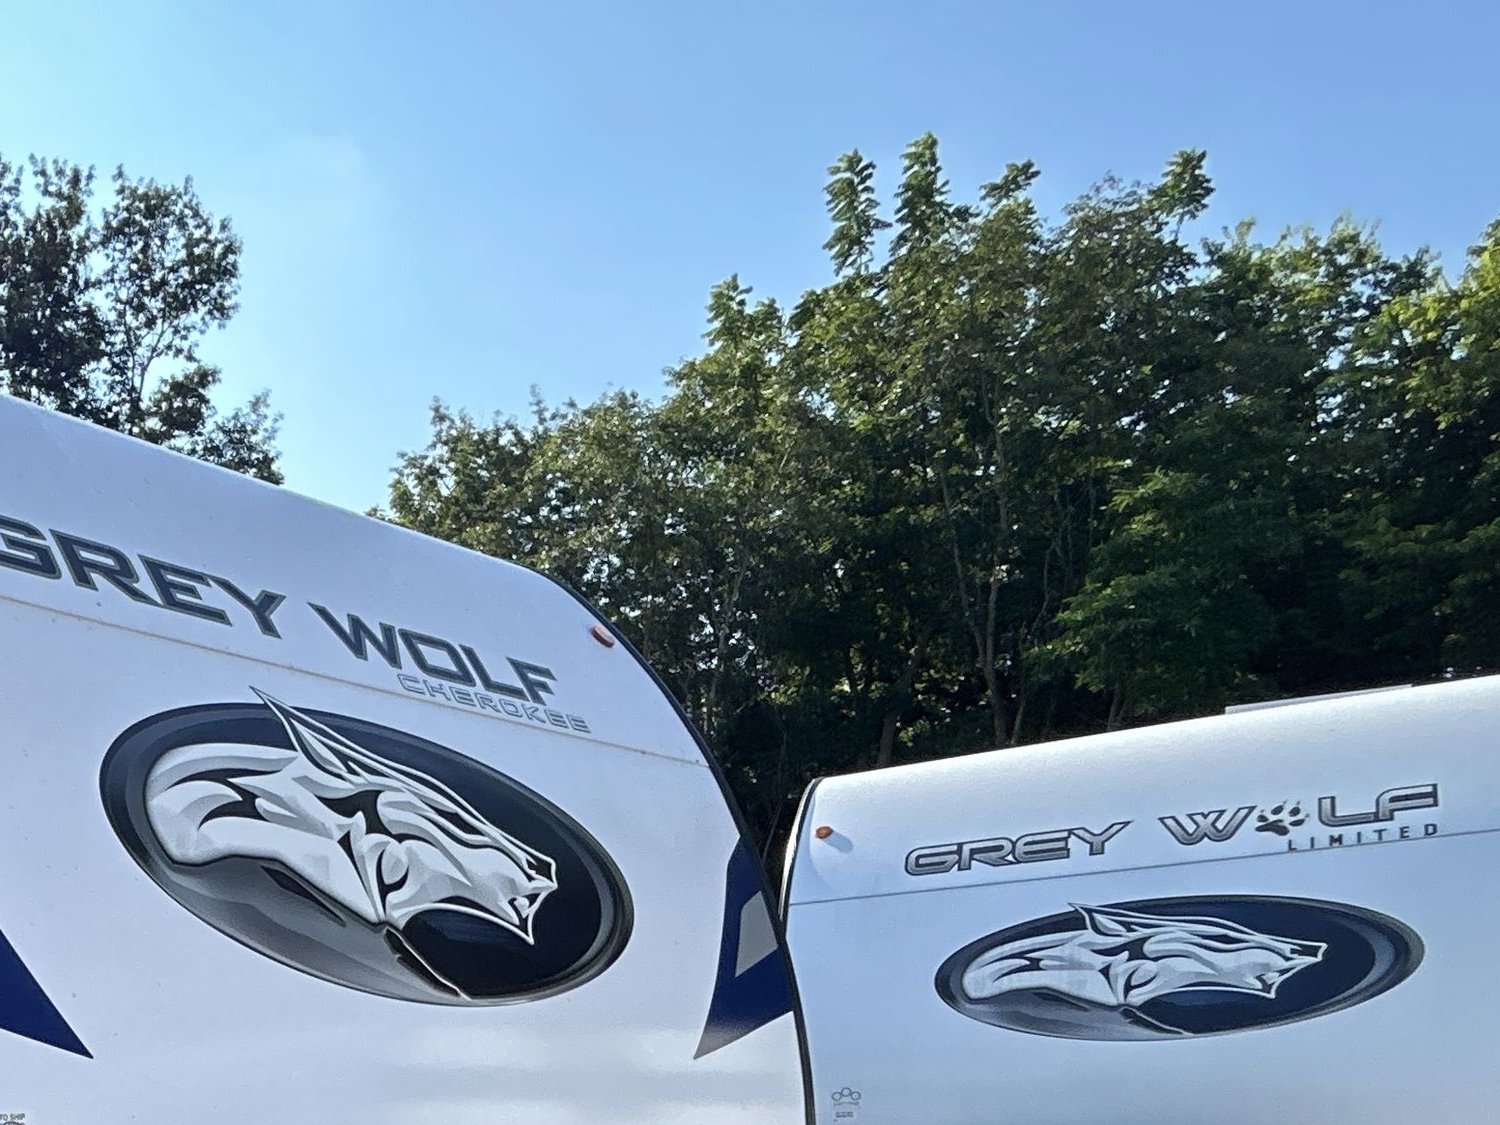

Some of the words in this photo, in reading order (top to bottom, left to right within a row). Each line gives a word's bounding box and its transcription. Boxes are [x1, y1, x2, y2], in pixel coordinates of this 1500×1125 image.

[306, 601, 558, 706] WOLF
[397, 673, 591, 734] CHEROKEE
[905, 820, 1134, 876] GREY
[1287, 823, 1438, 852] LIMITED
[0, 1113, 9, 1121] TO
